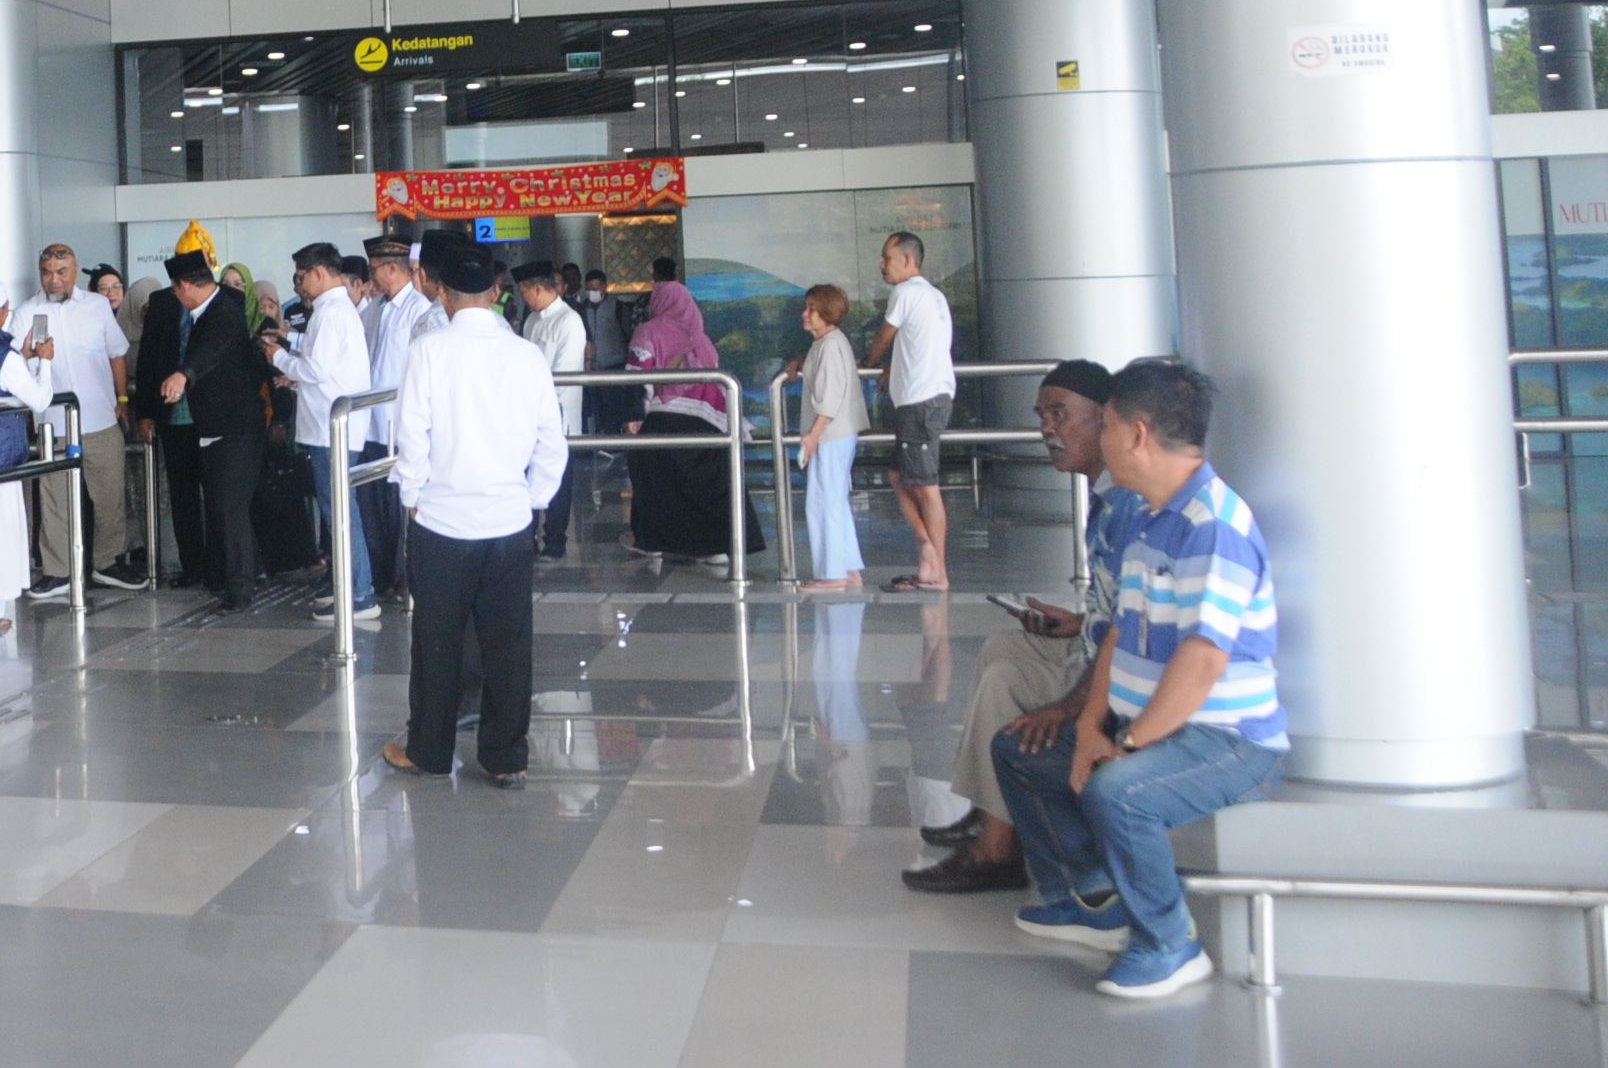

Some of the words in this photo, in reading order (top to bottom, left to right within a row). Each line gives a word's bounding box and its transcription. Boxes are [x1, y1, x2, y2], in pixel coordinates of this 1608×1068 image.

[392, 35, 473, 51] Kedatangan
[393, 55, 433, 66] Arrivals
[422, 178, 496, 195] Merry
[509, 172, 636, 193] Christmas
[433, 193, 508, 209] Happy
[479, 225, 492, 239] 2
